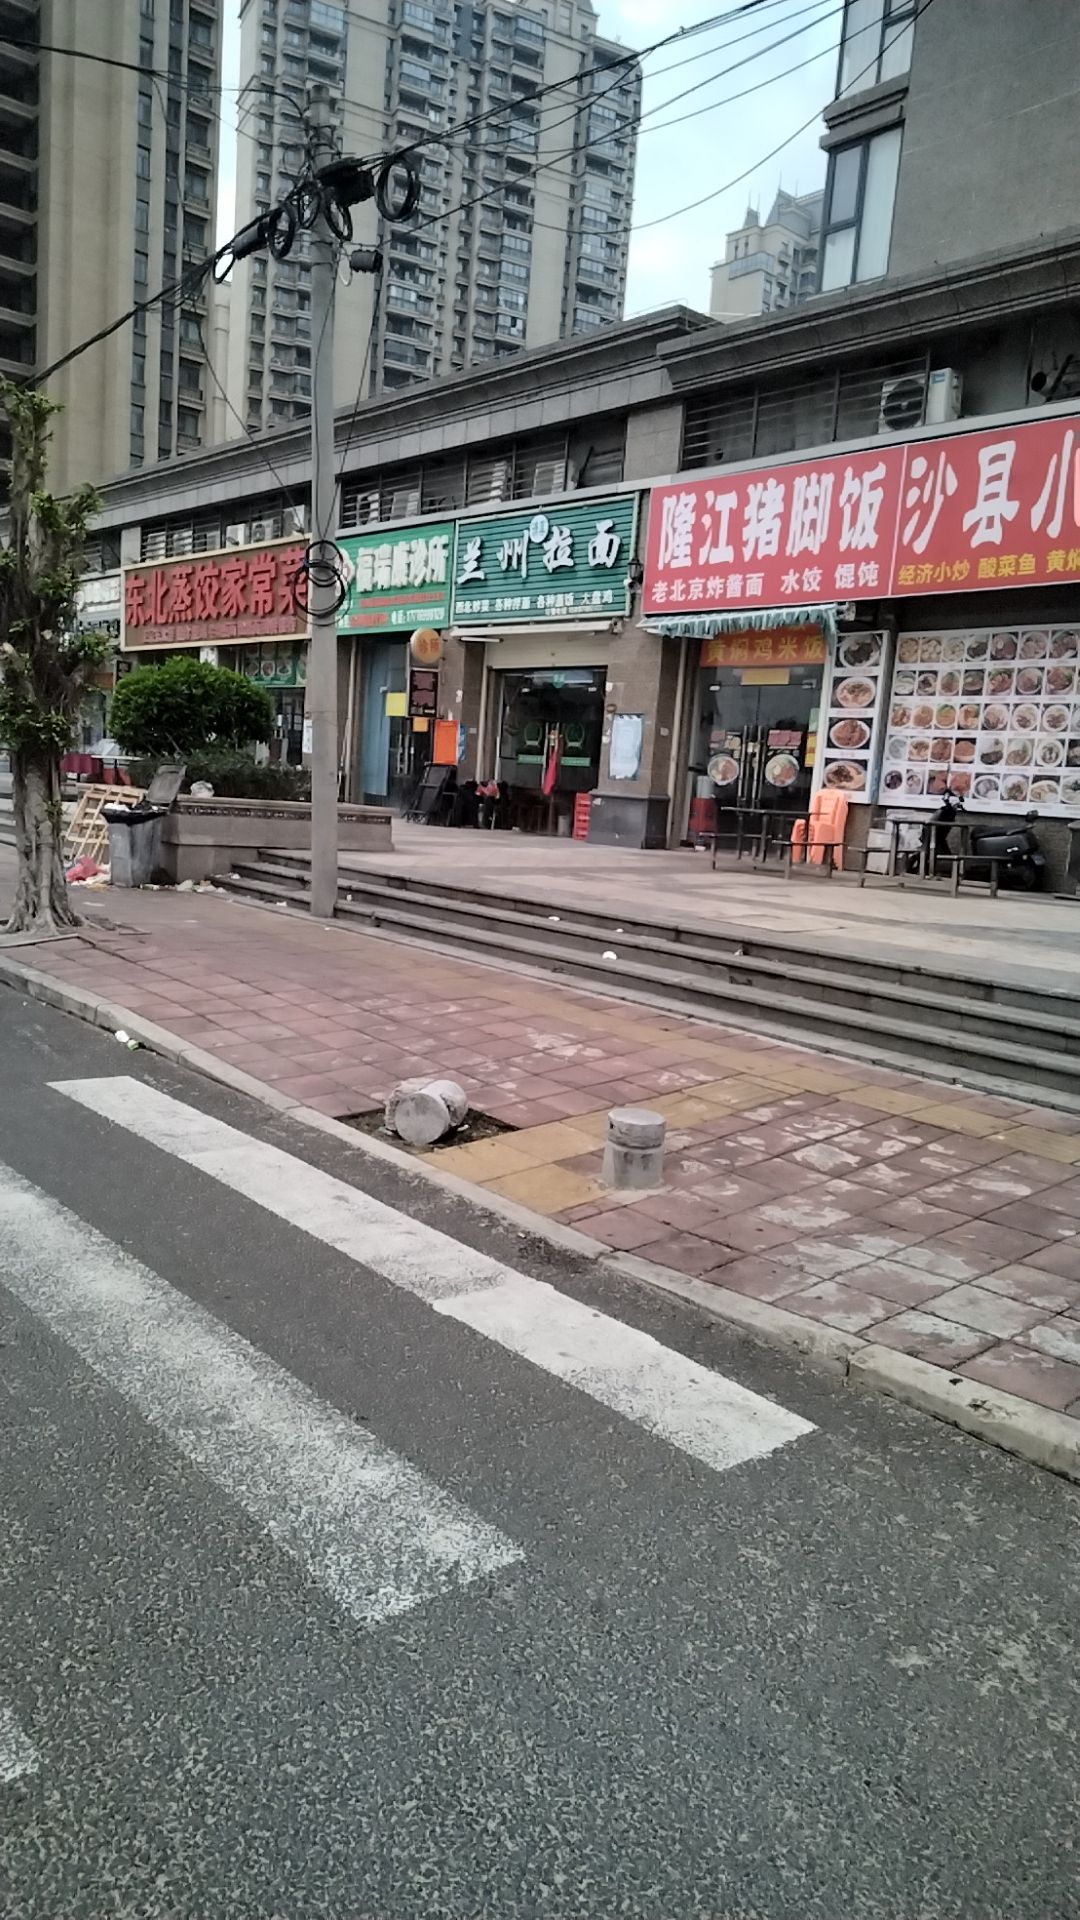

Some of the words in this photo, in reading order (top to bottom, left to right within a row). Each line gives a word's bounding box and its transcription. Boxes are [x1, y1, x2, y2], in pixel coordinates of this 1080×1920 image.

[658, 461, 887, 570] 隆江猪脚饭
[457, 519, 621, 584] 兰州拉面
[898, 559, 971, 586] 经济小炒
[978, 553, 1036, 579] 酸菜鱼
[125, 545, 309, 626] 东北蒸饺家常菜
[651, 572, 765, 603] 老北京炸酱面
[780, 566, 823, 595] 水饺
[834, 561, 879, 590] 馄饨
[707, 634, 823, 662] 黄焖鸡米饭
